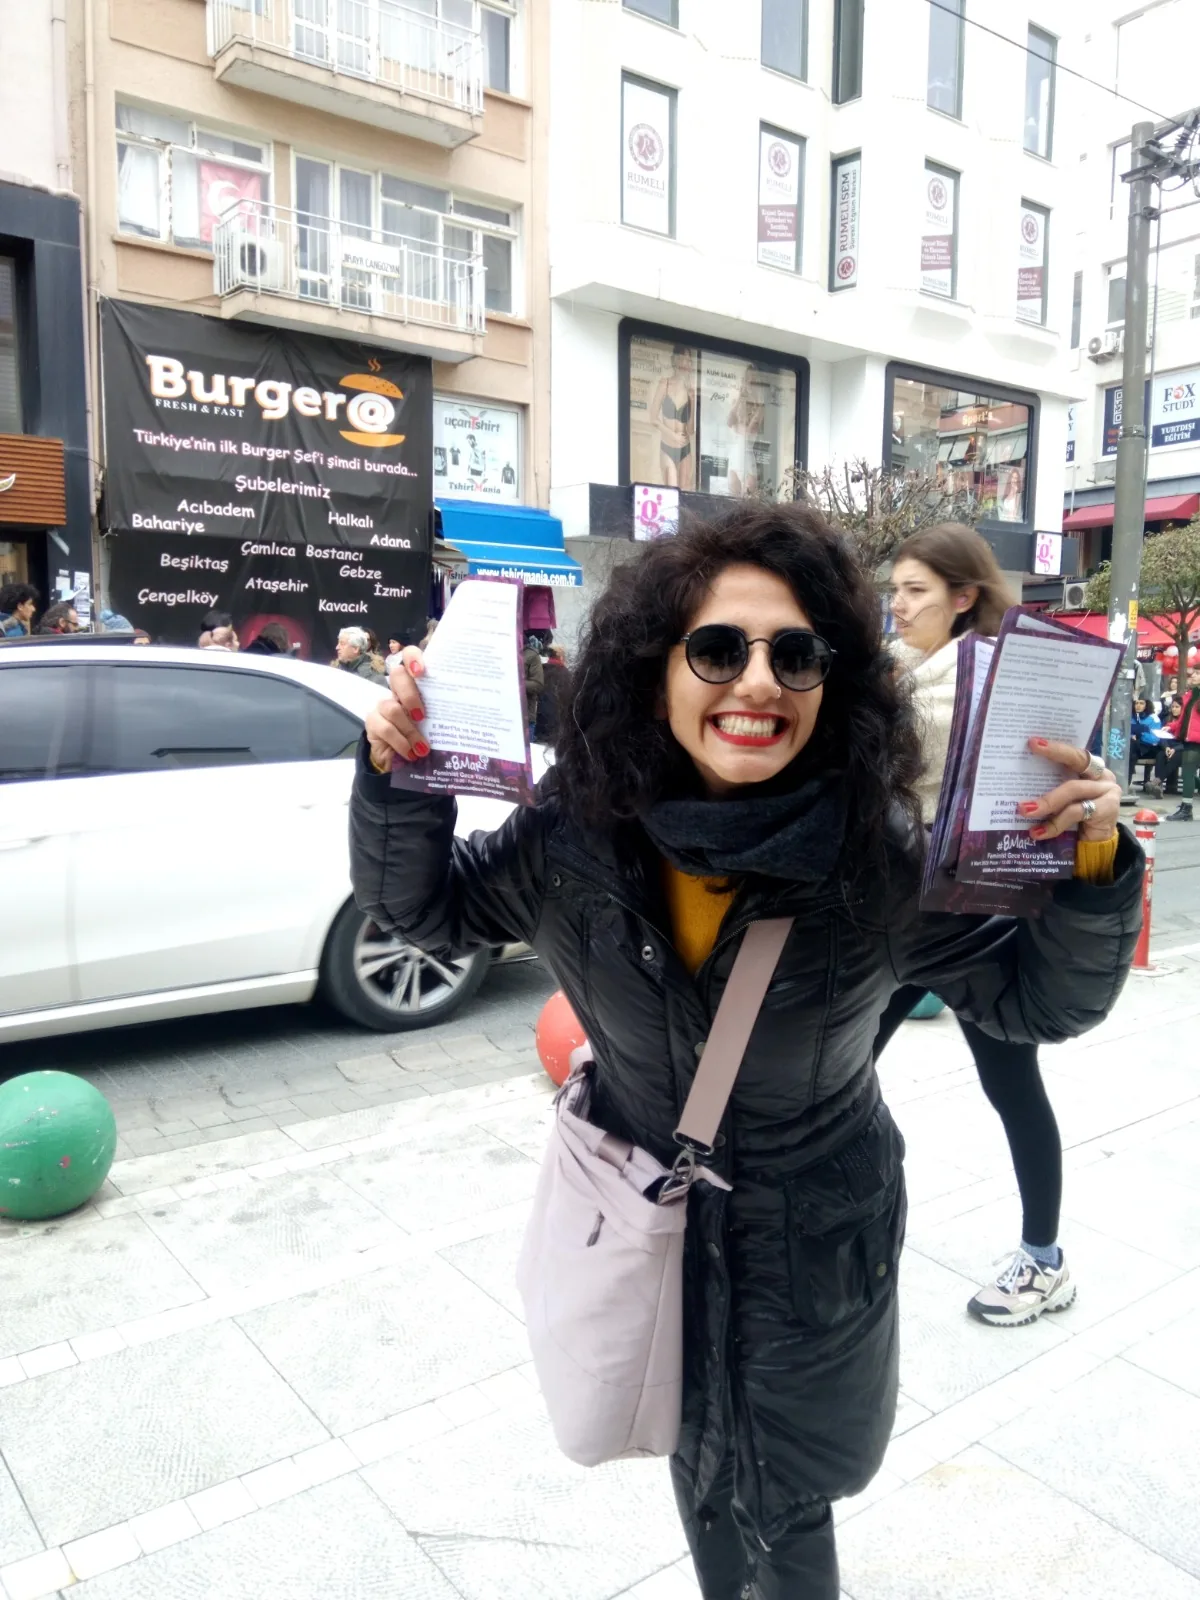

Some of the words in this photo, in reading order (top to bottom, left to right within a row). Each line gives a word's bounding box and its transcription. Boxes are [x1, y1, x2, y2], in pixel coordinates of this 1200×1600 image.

[1164, 383, 1196, 402] FOX
[155, 399, 197, 413] FRESH
[201, 406, 209, 414] &
[214, 405, 244, 418] FAST
[1162, 399, 1196, 413] STUDY
[133, 429, 216, 452] Türkiye'nin
[220, 439, 237, 455] ilk
[242, 443, 290, 462] Burger
[294, 448, 323, 466] Şef'i
[327, 453, 361, 471] şimdi
[364, 460, 418, 477] burada...
[235, 475, 331, 499] Şubelerimiz
[177, 499, 255, 518] Acıbadem
[132, 514, 205, 535] Bahariye
[328, 512, 373, 529] Halkalı
[241, 541, 296, 558] Çamlıca
[306, 545, 363, 561] Bostancı
[370, 534, 411, 549] Adana
[161, 553, 229, 572] Beşiktaş
[339, 565, 382, 580] Gebze
[245, 577, 308, 593] Ataşehir
[374, 582, 411, 598] İzmir
[138, 588, 219, 608] Çengelköy
[319, 599, 368, 613] Kavacık
[1022, 852, 1054, 860] Yürüyüşü
